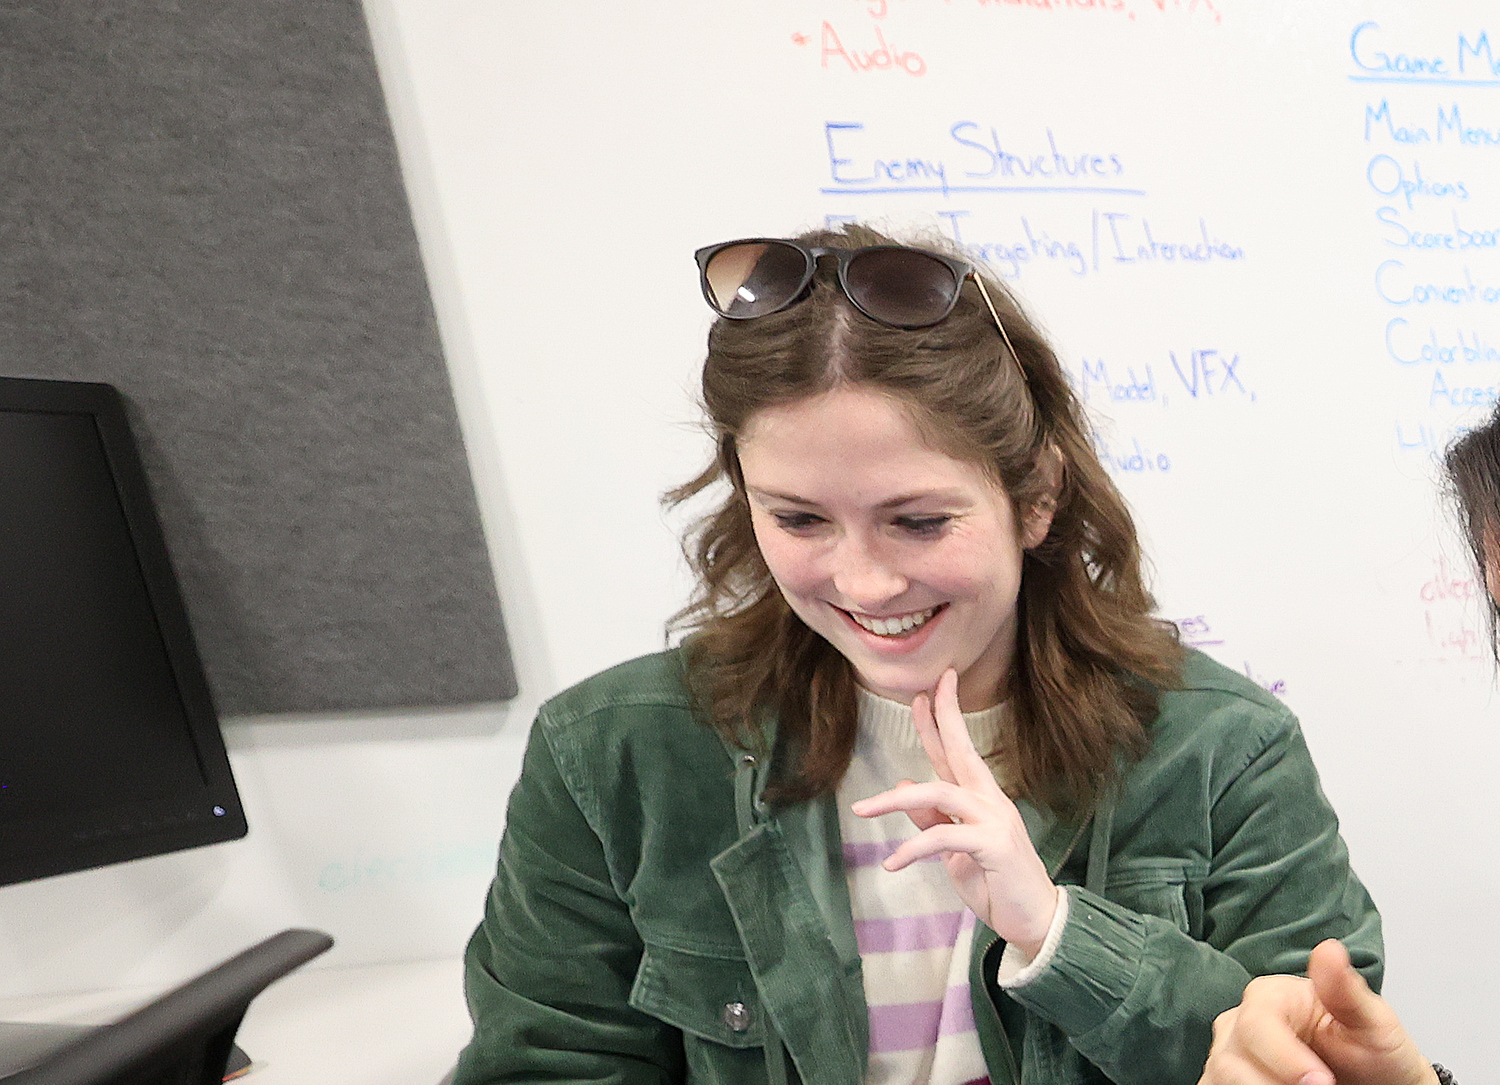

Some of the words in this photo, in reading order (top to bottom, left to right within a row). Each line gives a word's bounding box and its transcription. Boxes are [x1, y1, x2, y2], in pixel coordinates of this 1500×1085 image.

[820, 19, 928, 77] Audio
[1348, 19, 1451, 75] Game
[1363, 95, 1431, 145] Main
[823, 120, 948, 200] Enemy
[949, 119, 1125, 180] Structures
[1366, 152, 1470, 212] Options
